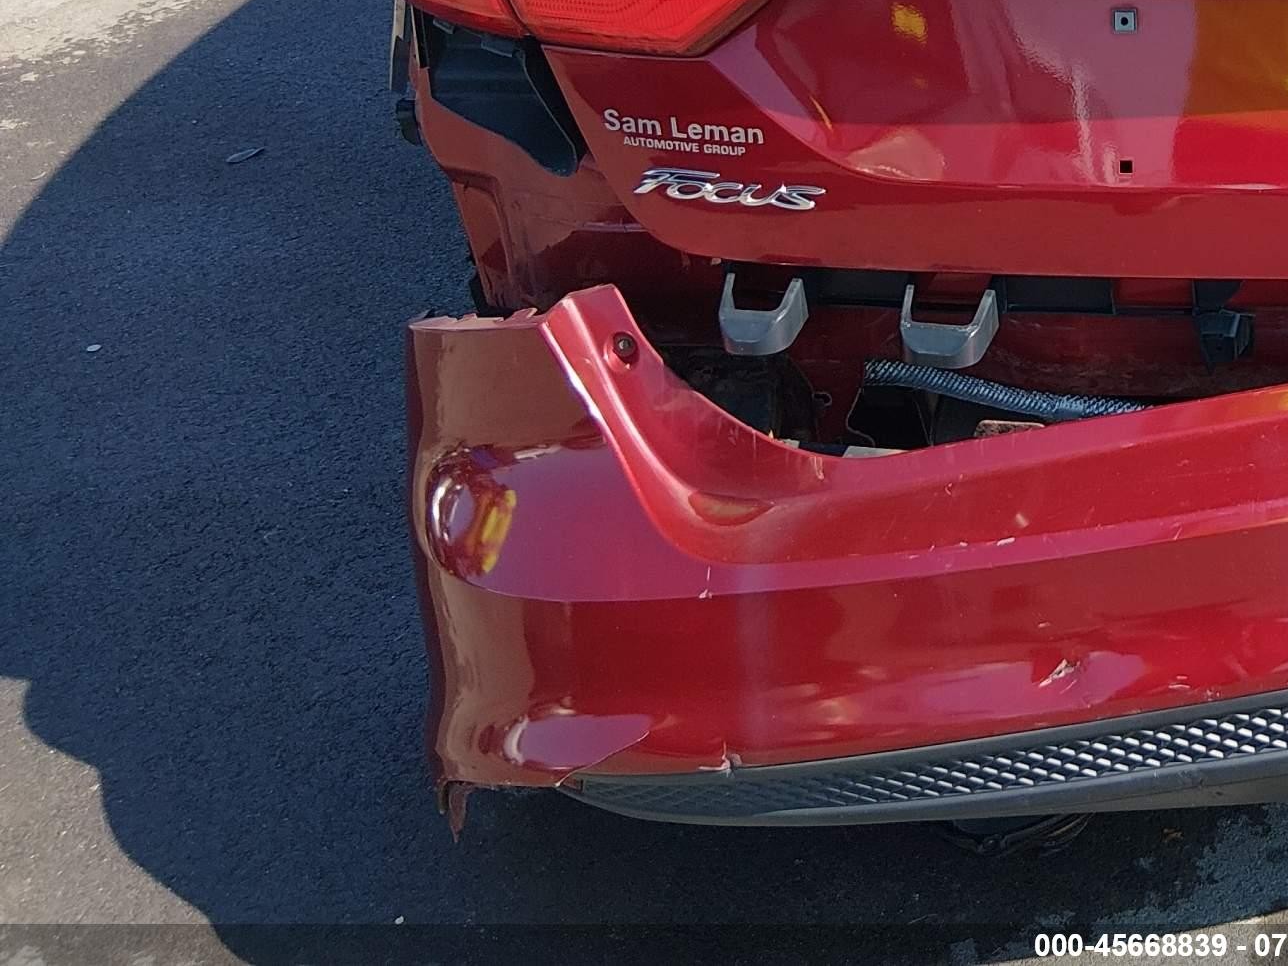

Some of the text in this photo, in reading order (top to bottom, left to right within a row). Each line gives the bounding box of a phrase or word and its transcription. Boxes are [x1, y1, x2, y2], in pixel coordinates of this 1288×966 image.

[603, 109, 765, 145] Sam Leman
[623, 136, 747, 157] AUTOMOTIVE GROUP
